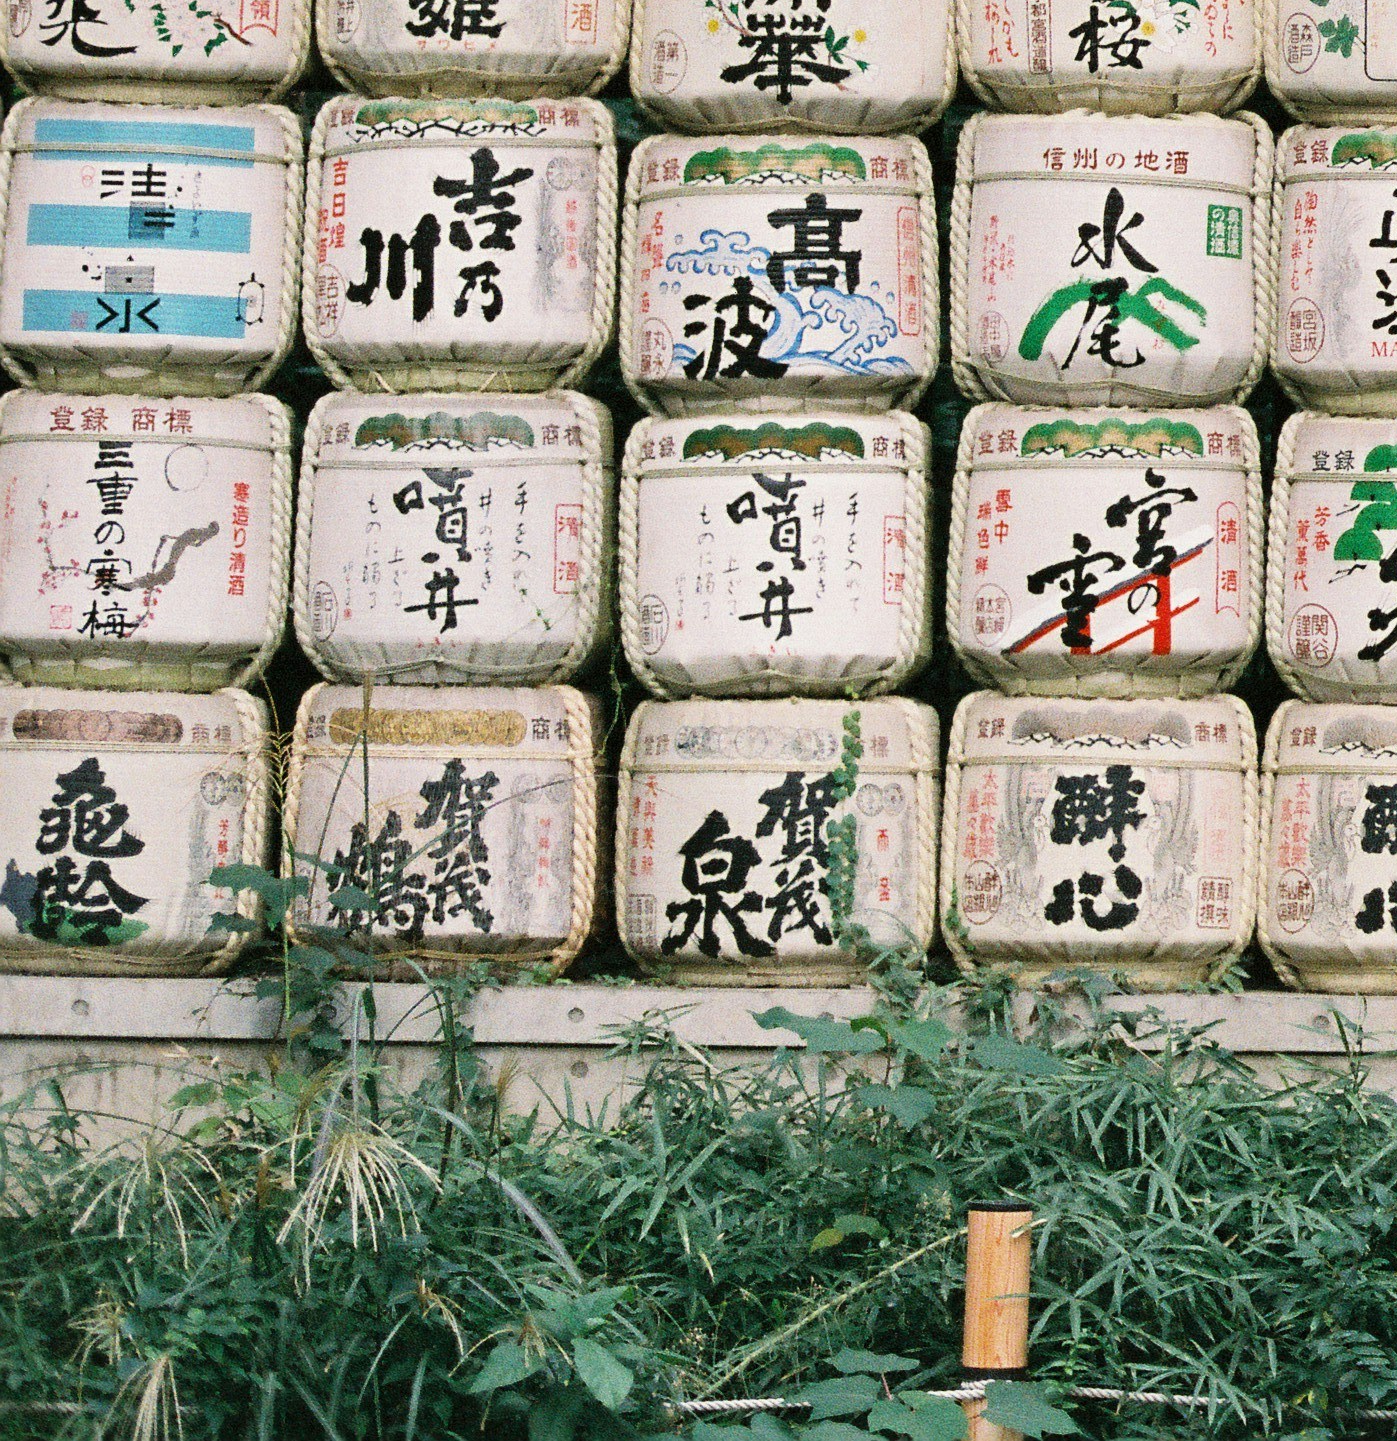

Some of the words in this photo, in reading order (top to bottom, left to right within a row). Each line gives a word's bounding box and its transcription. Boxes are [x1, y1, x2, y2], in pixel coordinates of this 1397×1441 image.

[1043, 148, 1189, 174] 信州の地酒
[1062, 187, 1158, 371] 水尾
[1312, 451, 1354, 471] 登録
[78, 442, 140, 638] 三重の寒梅
[995, 489, 1011, 541] 雪中
[1314, 506, 1330, 551] 芳香
[1220, 521, 1238, 592] 清酒
